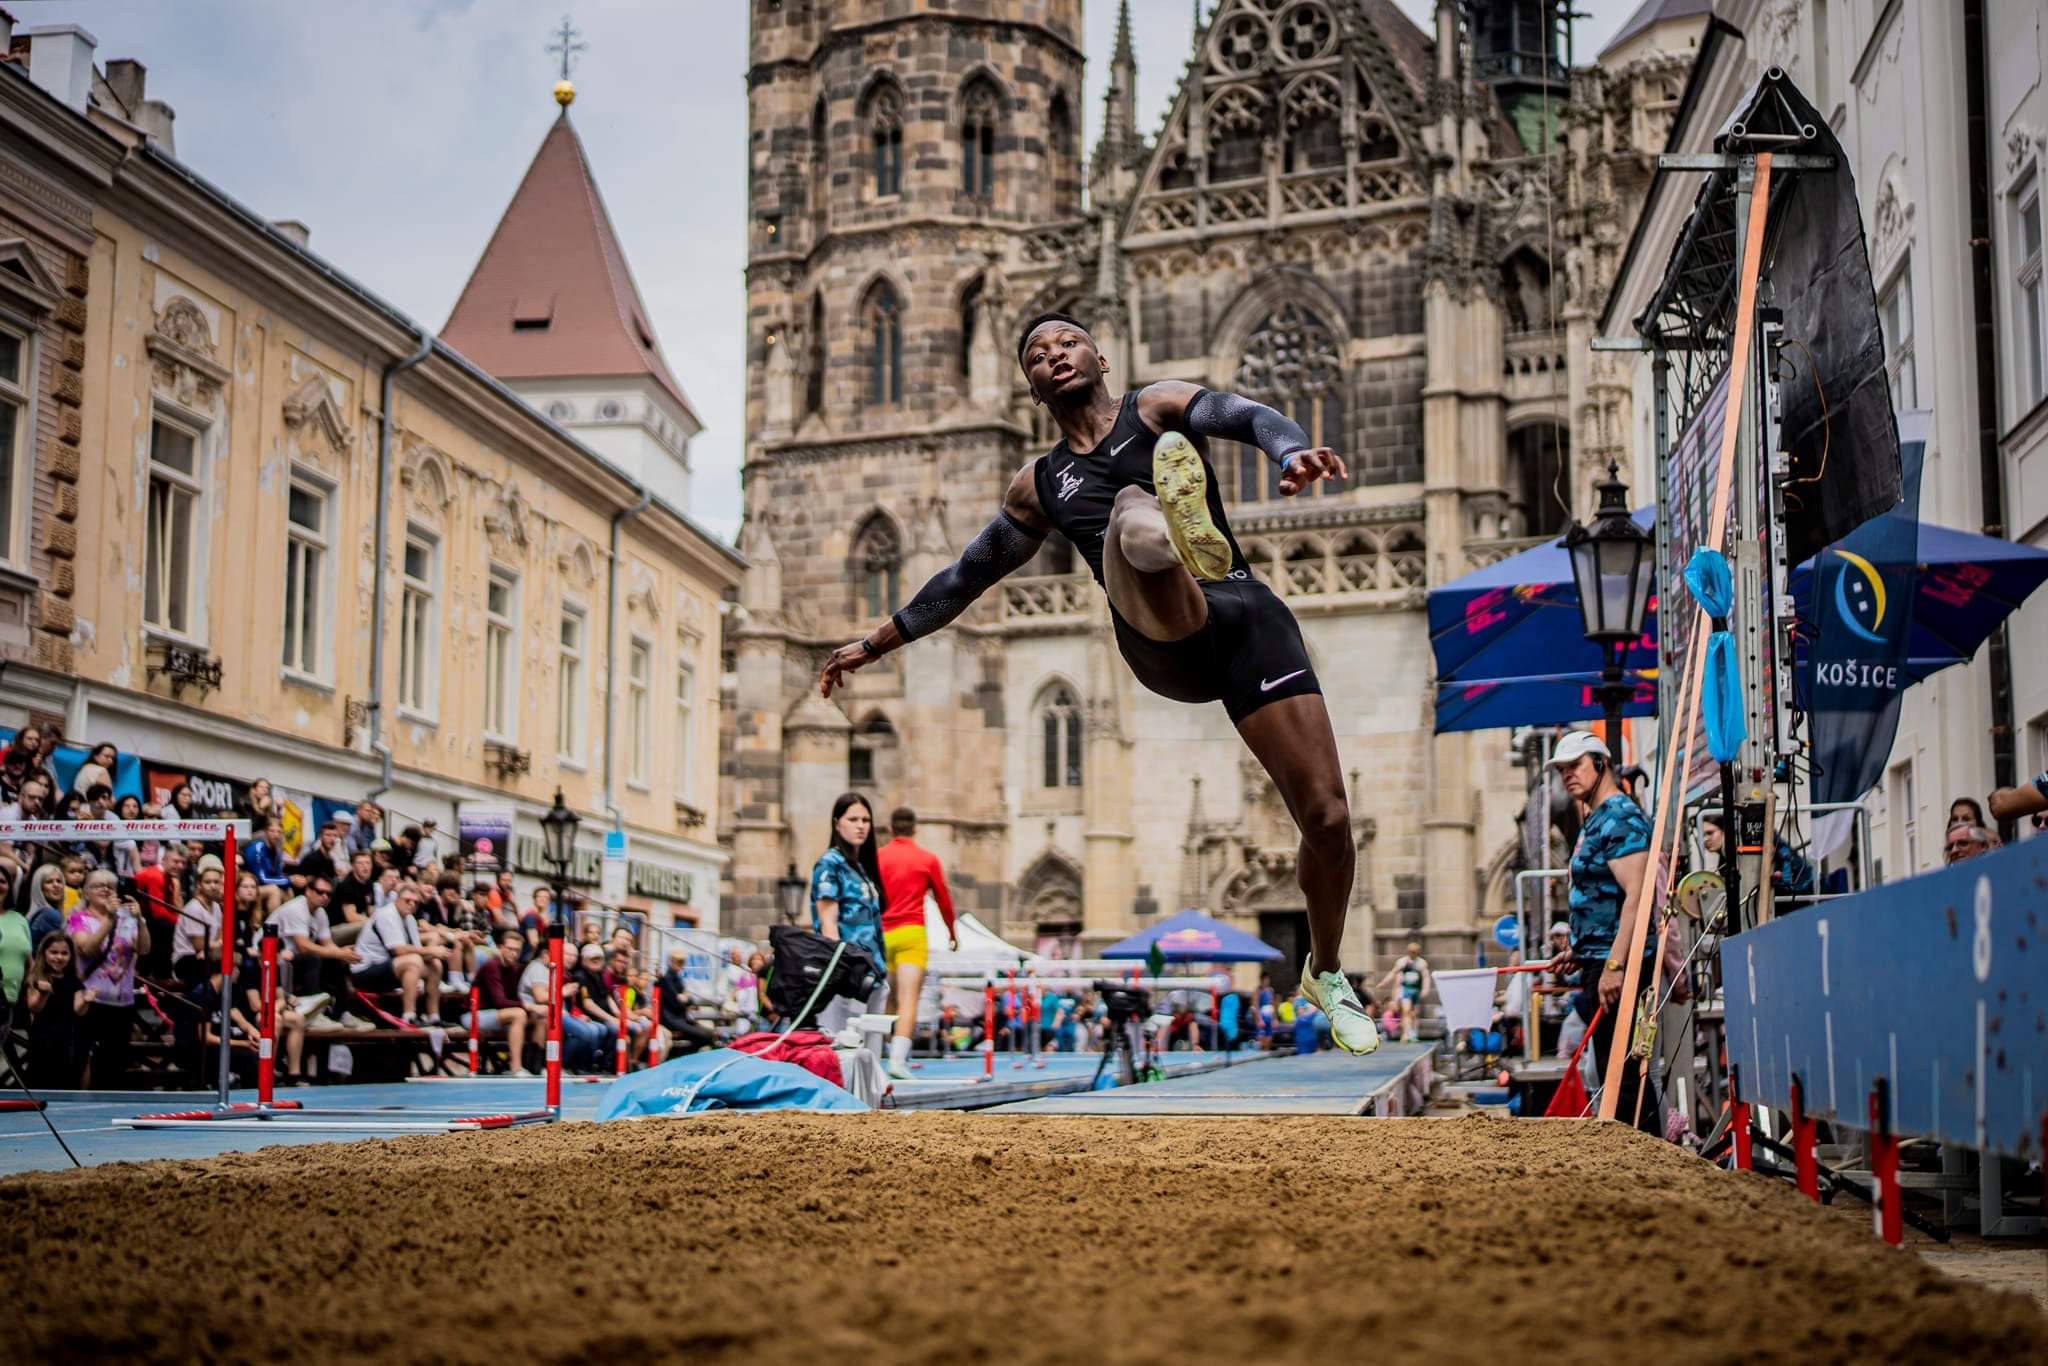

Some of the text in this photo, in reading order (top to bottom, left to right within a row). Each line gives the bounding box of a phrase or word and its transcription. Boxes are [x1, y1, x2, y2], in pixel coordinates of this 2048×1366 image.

[1816, 659, 1897, 689] KOŠICE
[190, 775, 233, 810] SPORT
[1973, 874, 1992, 983] 8
